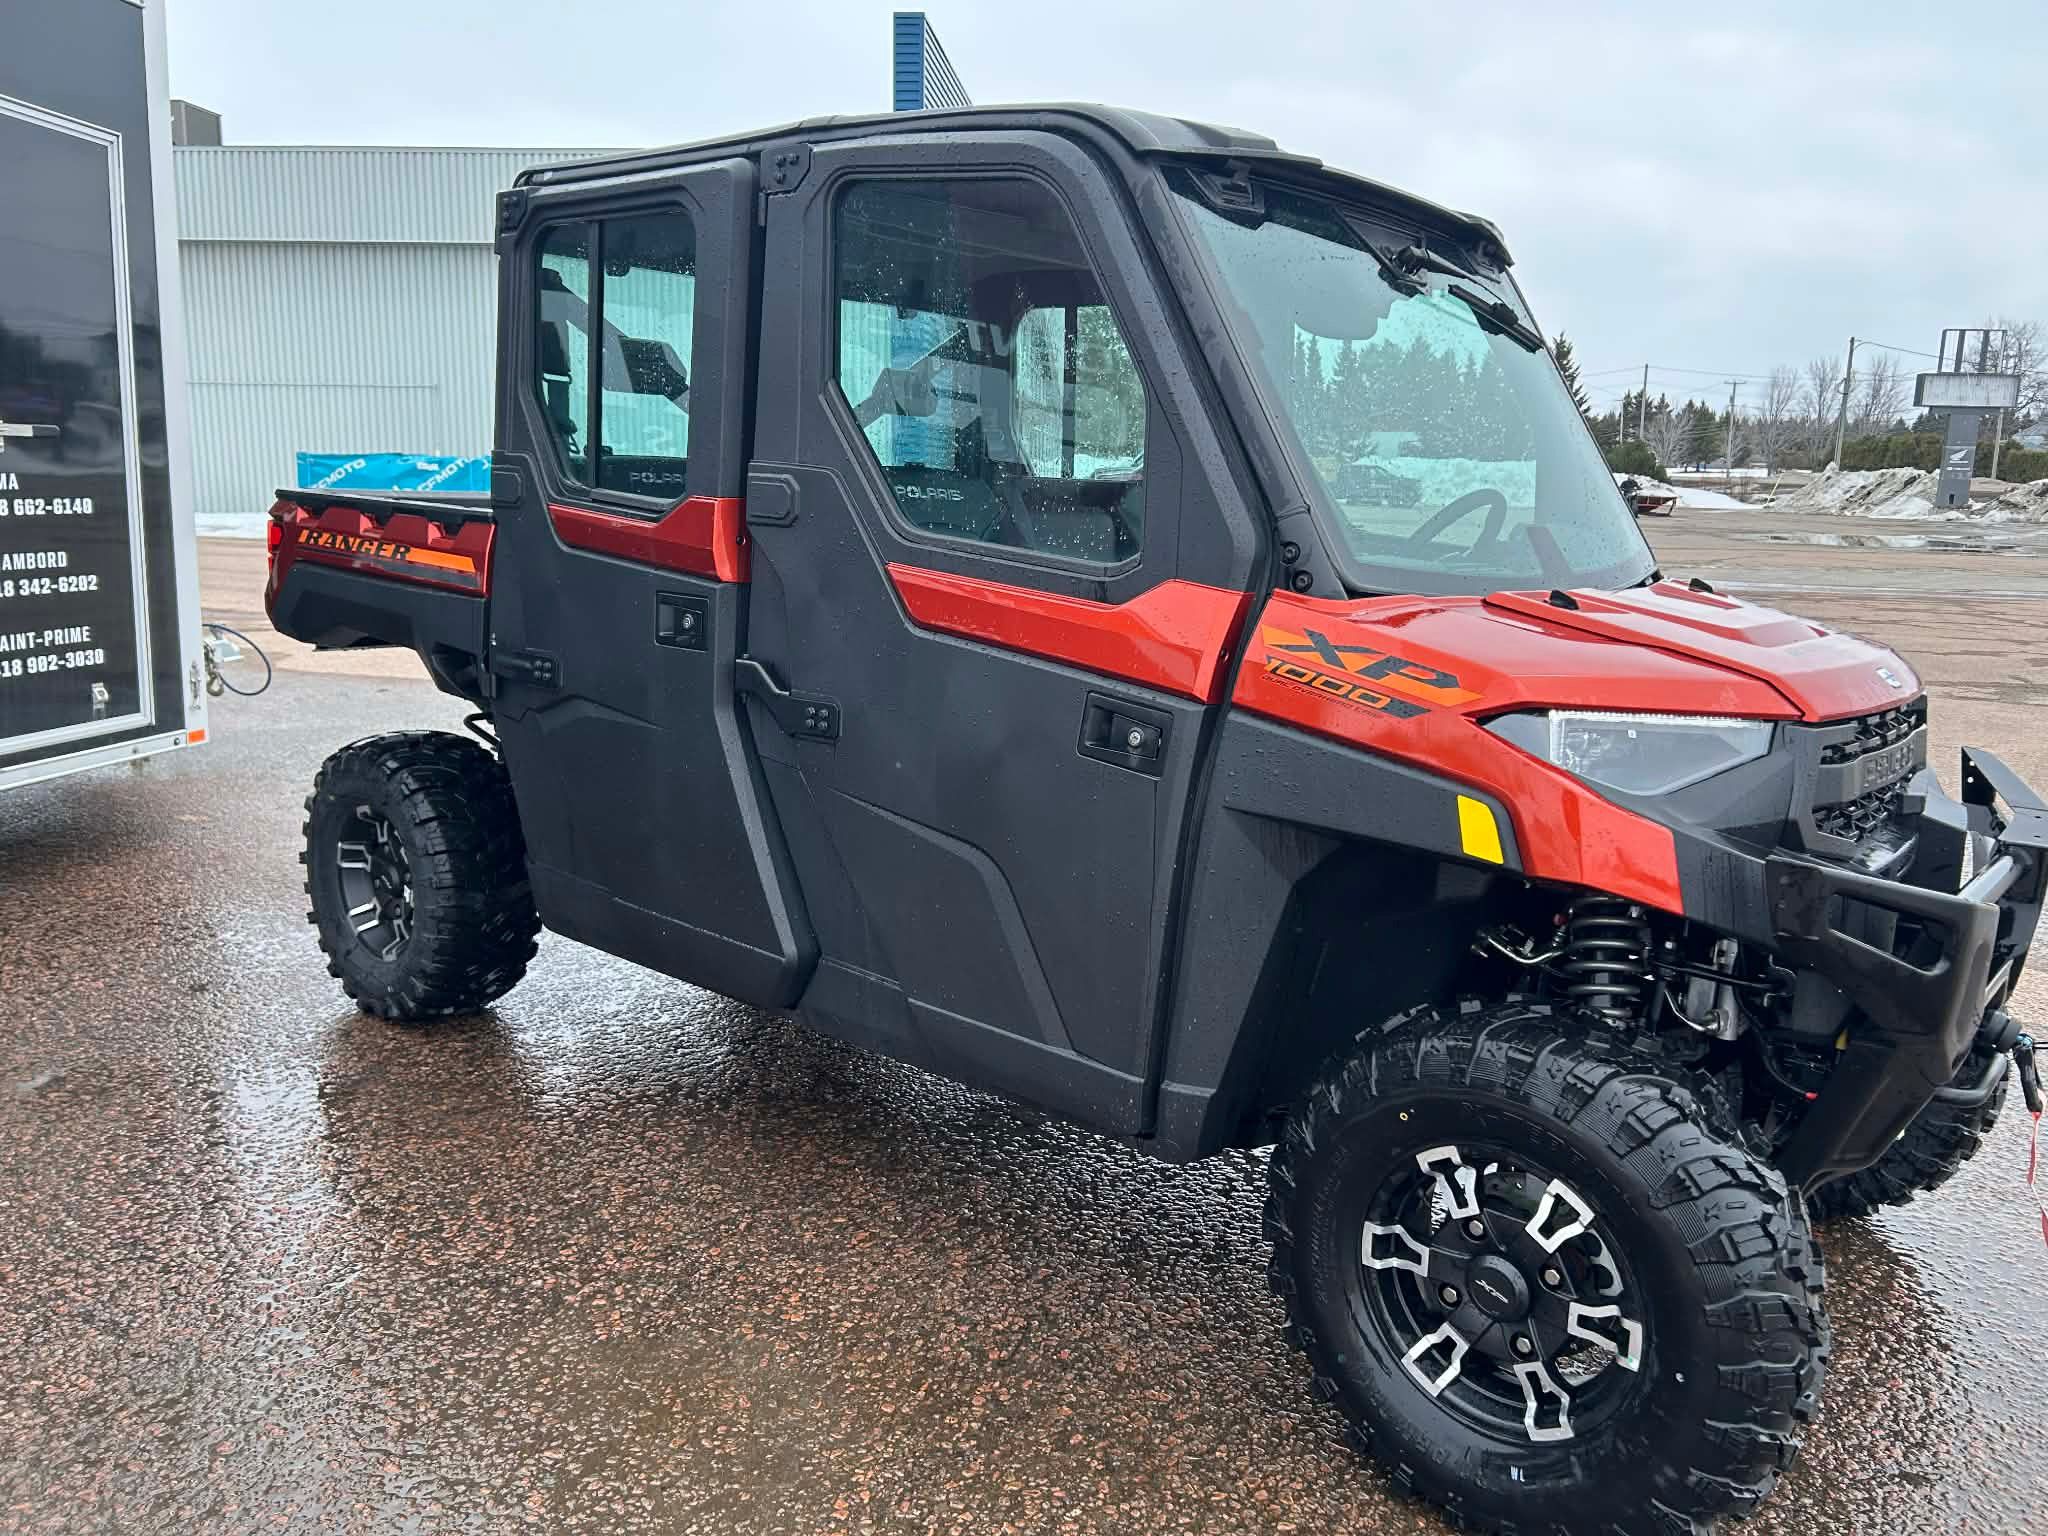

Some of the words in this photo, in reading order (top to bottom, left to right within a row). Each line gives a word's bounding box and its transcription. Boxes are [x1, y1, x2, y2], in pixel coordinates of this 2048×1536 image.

[895, 485, 963, 501] POLARIS
[299, 528, 412, 560] RANGER
[0, 580, 15, 597] 8
[19, 574, 98, 596] 342-6202
[27, 648, 104, 674] 902-3030
[1268, 628, 1461, 689] XP
[1264, 657, 1392, 710] 1000
